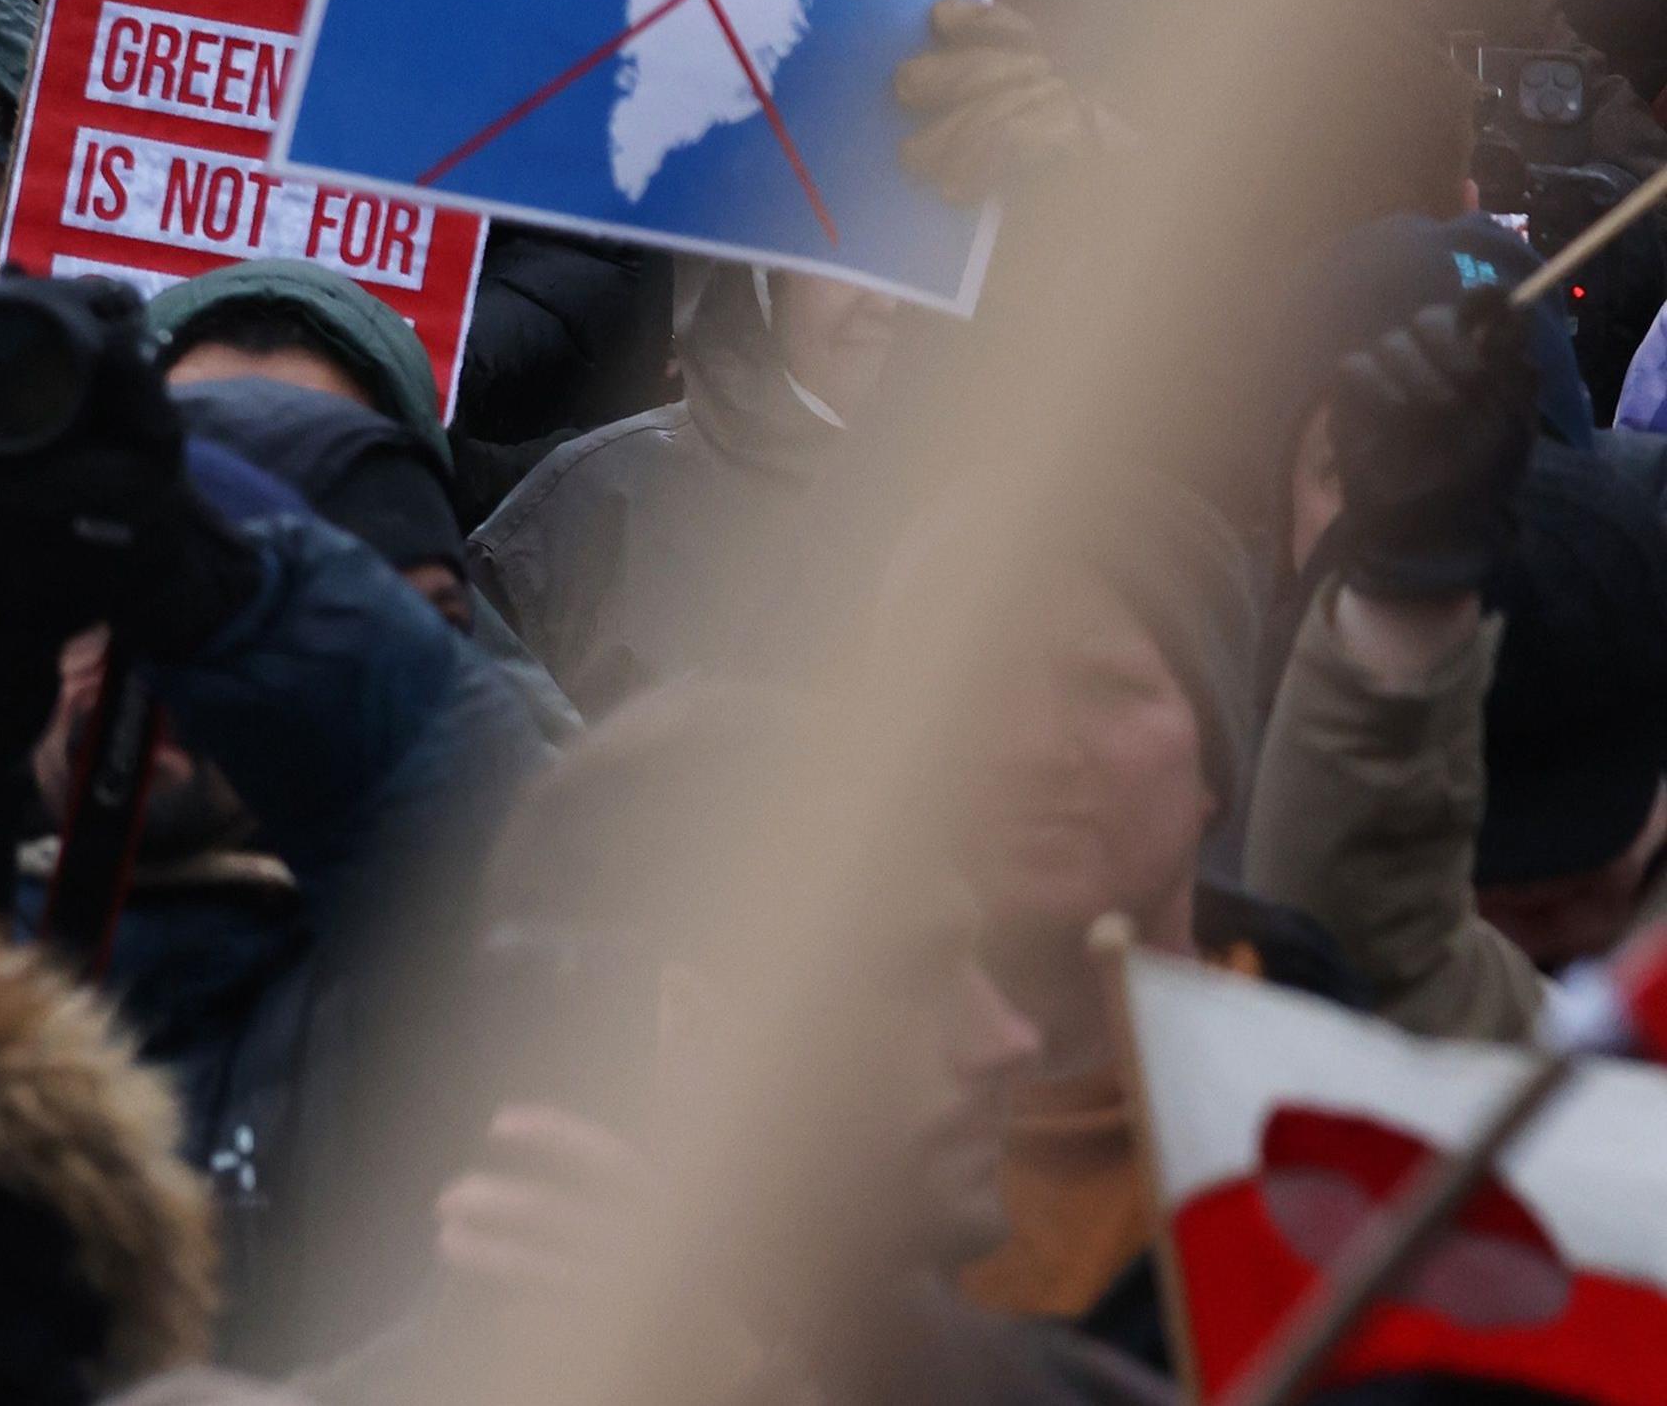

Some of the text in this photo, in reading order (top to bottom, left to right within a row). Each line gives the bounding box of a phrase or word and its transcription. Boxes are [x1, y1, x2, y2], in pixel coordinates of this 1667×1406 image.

[102, 17, 297, 121] GREEN
[75, 141, 422, 276] IS NOT FOR
